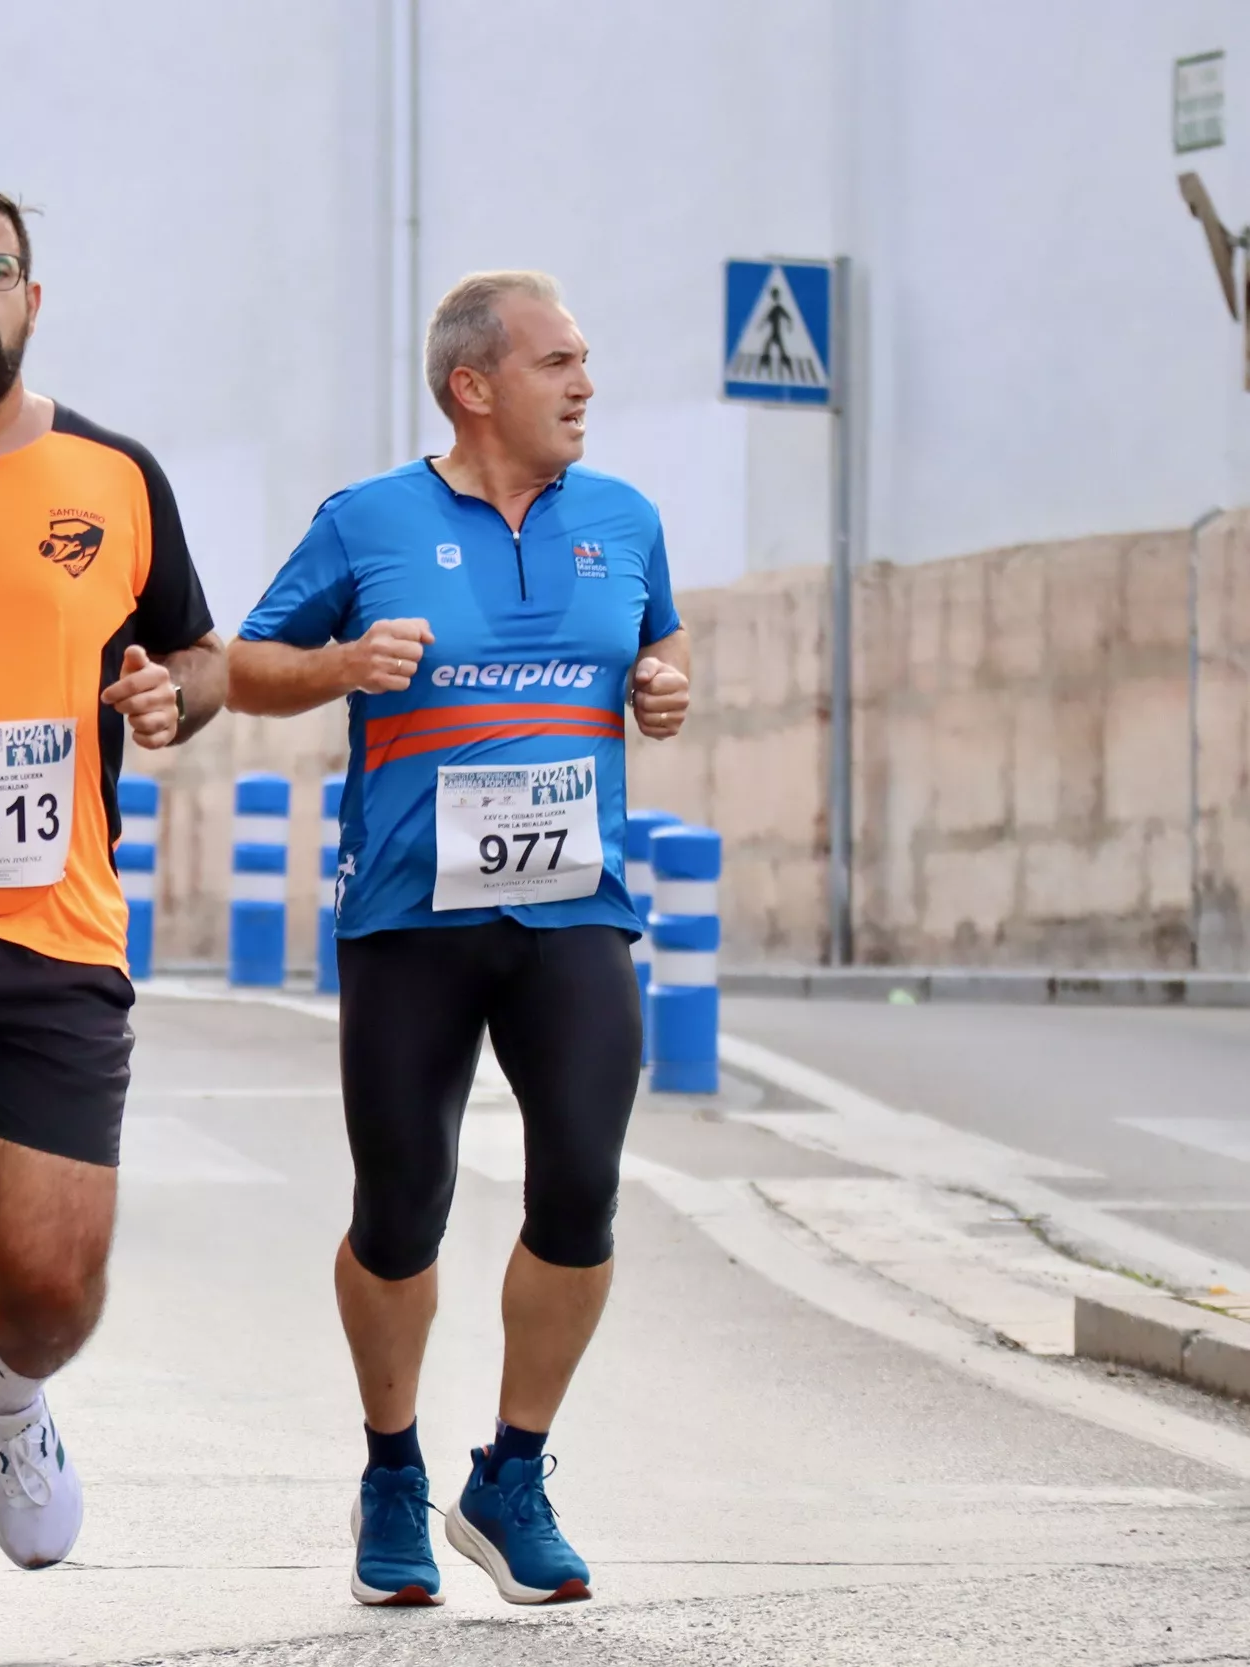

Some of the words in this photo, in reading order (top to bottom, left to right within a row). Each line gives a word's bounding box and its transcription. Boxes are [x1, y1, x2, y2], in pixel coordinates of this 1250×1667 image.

[49, 508, 106, 524] SANTUARIO
[574, 556, 595, 565] Club
[431, 660, 599, 692] enerplus
[5, 725, 45, 747] 2024
[531, 766, 571, 788] 2024
[479, 829, 568, 875] 977
